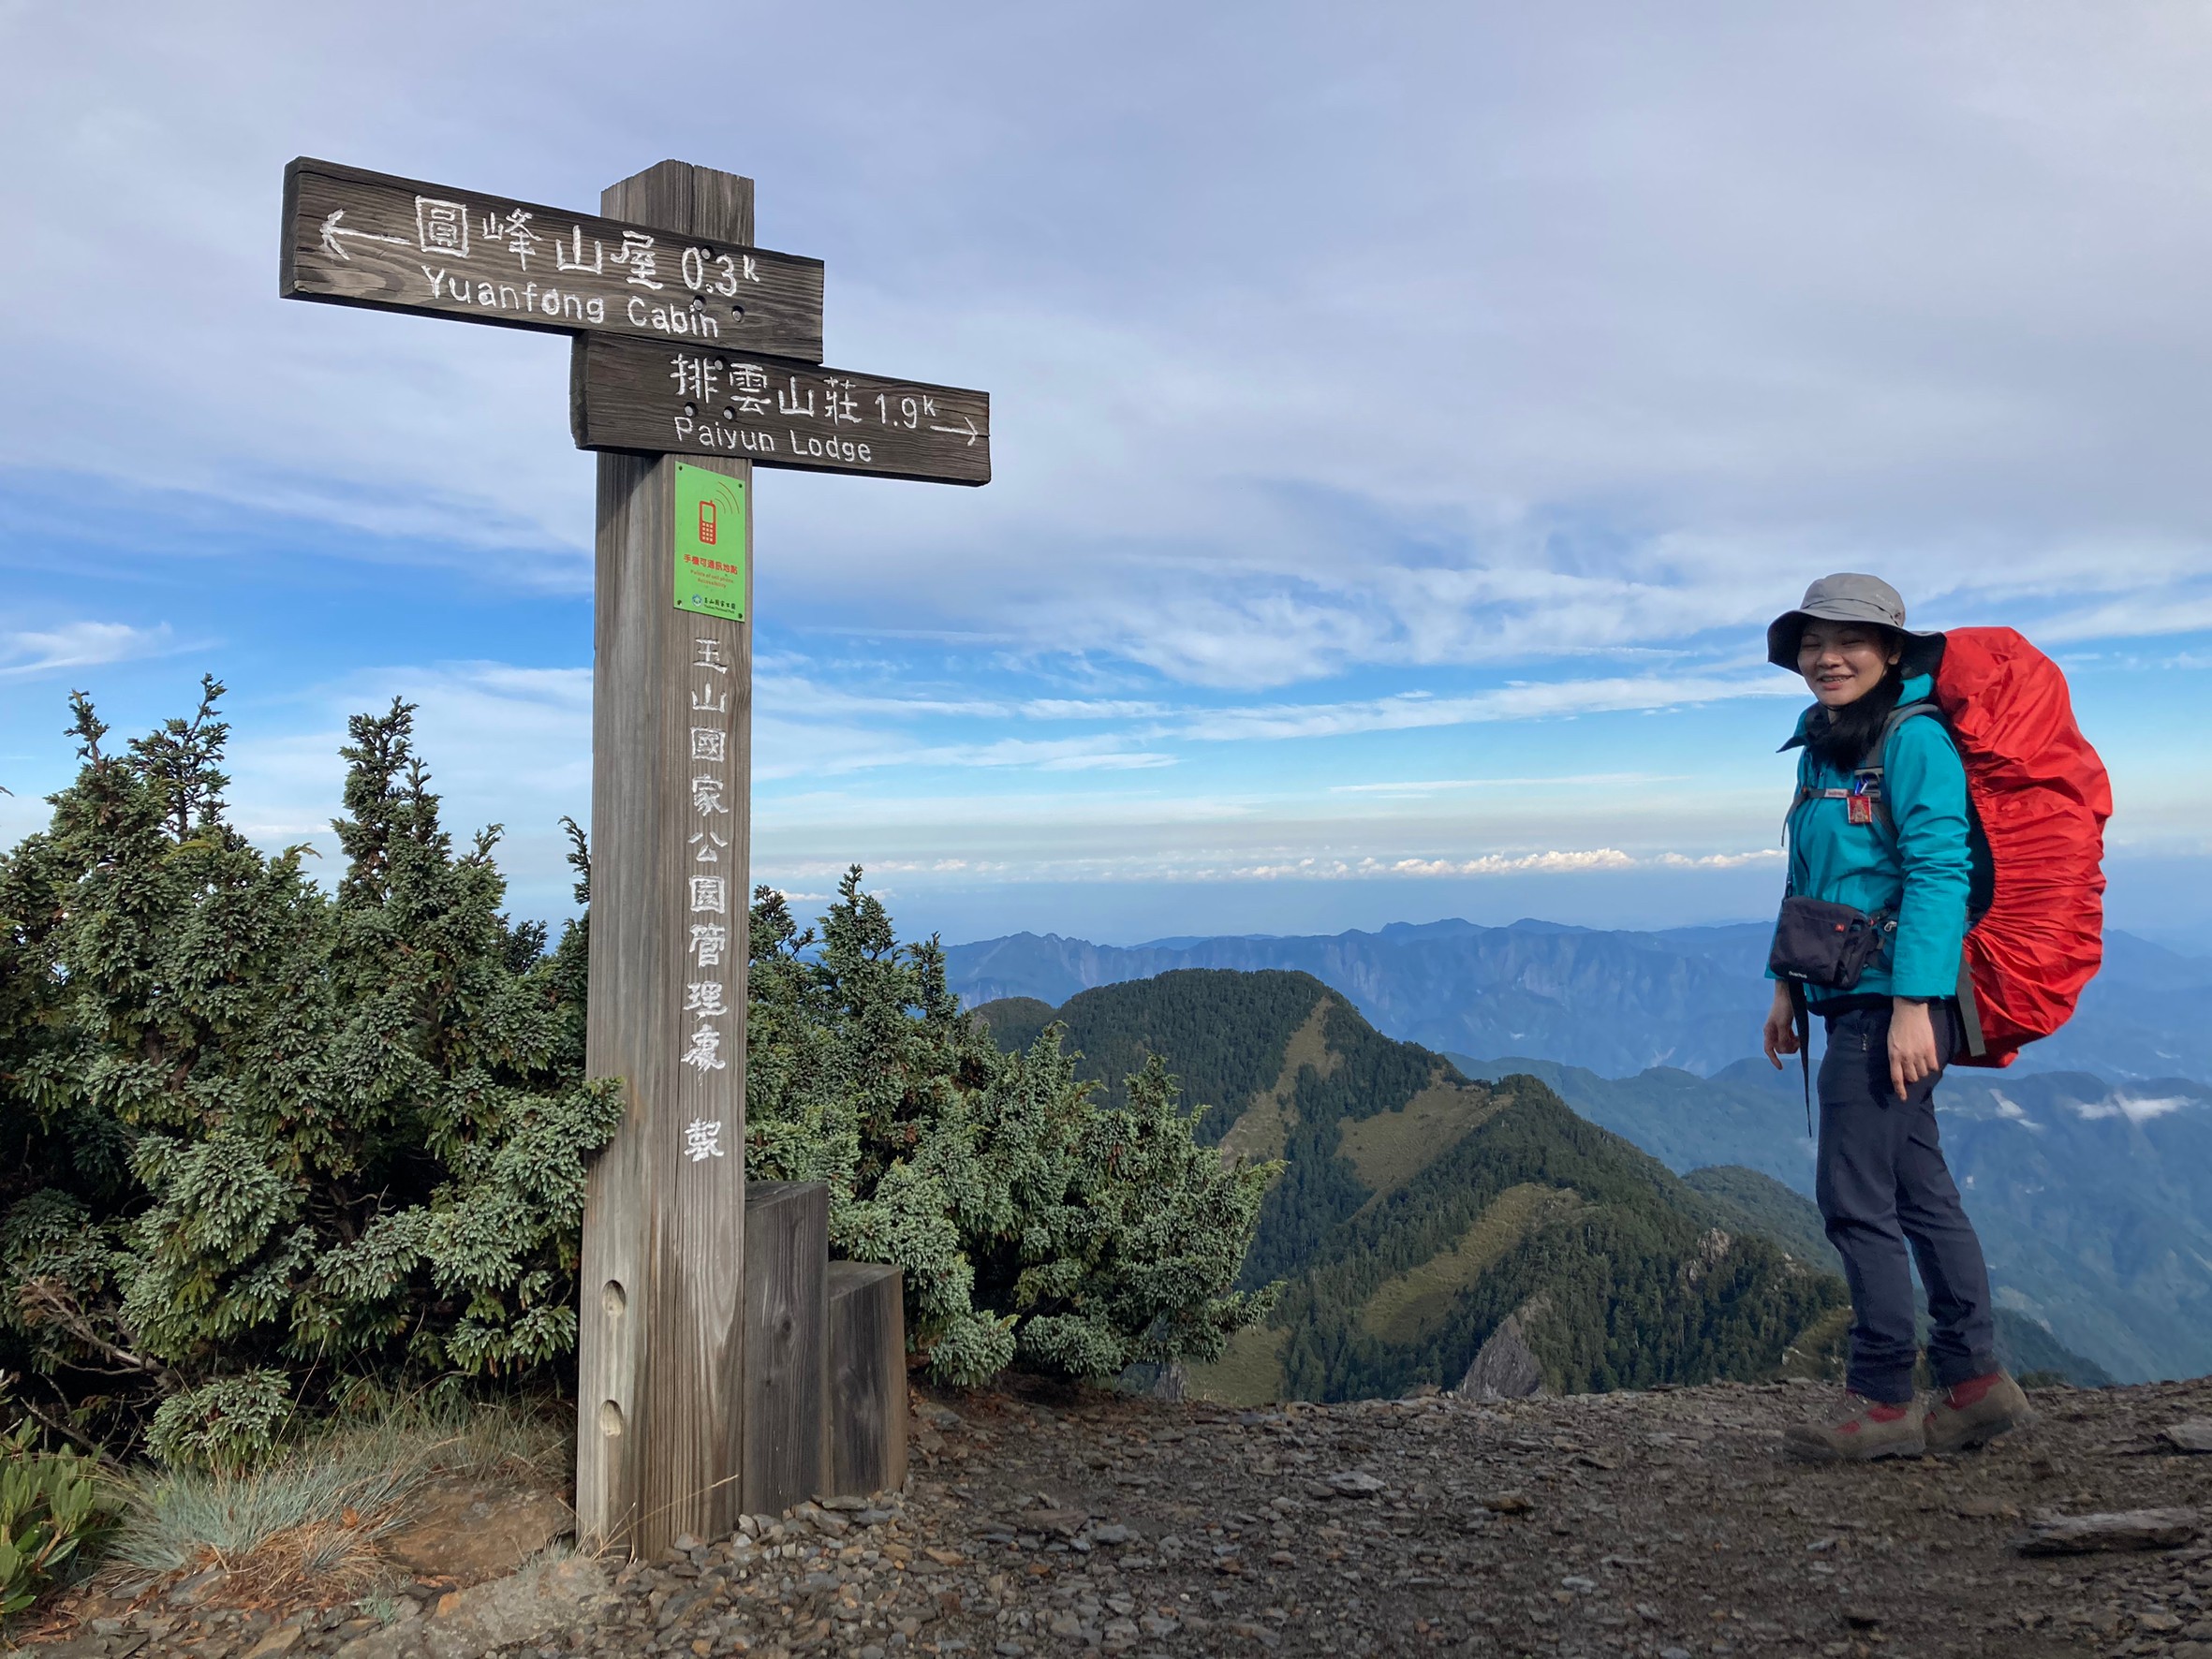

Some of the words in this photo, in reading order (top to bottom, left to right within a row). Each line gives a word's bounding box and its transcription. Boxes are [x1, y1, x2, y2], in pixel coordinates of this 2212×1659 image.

[415, 195, 663, 290] 圓峰山屋
[420, 264, 605, 324] Yuanfong
[627, 295, 718, 338] Cabin
[669, 353, 862, 425] 排雲山莊
[674, 416, 775, 451] Paiyun
[789, 429, 872, 462] Lodge
